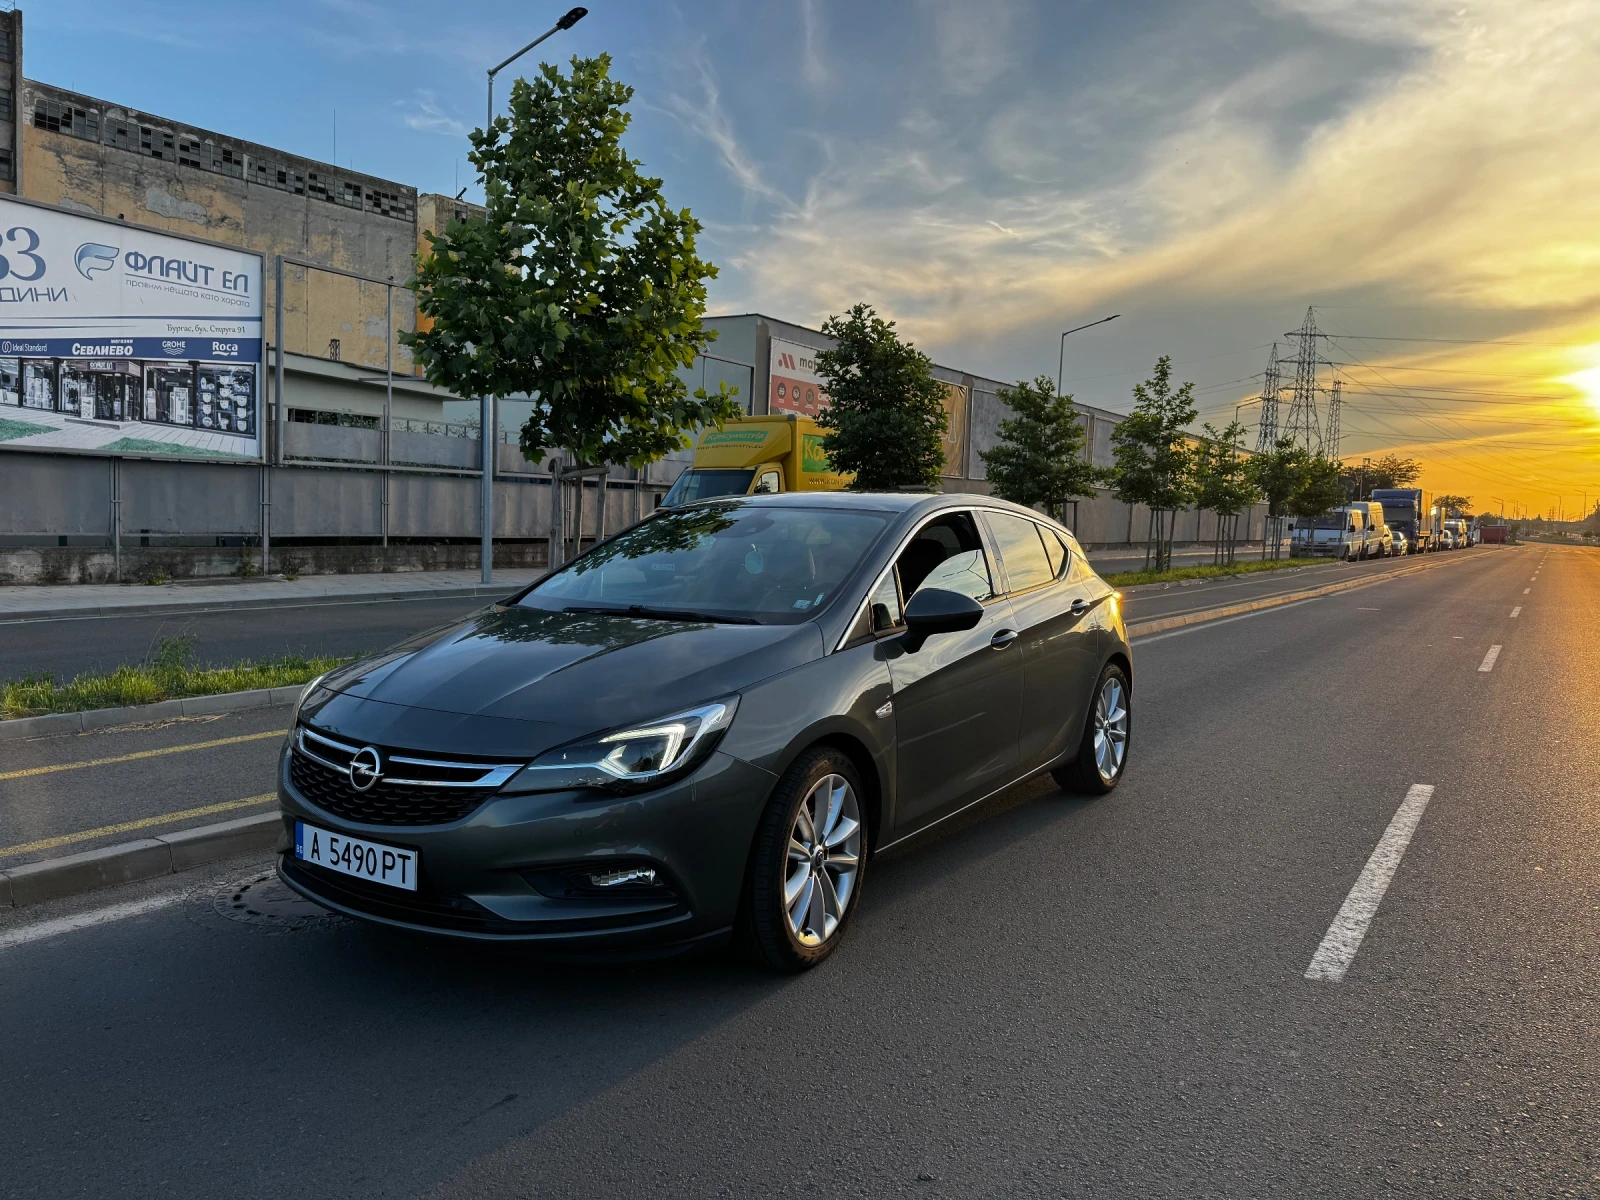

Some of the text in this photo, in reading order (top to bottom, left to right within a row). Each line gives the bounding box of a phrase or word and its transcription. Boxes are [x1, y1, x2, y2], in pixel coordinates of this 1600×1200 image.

[0, 227, 46, 281] 3
[124, 251, 249, 293] ФЛАЙТ ЕЛ
[126, 279, 250, 308] правим нещата като хората
[167, 324, 246, 335] Бургас, бул. Струга 91
[12, 343, 48, 352] Ideal Standard
[162, 340, 186, 348] GROHE
[212, 341, 239, 351] Roca
[311, 832, 320, 860] A
